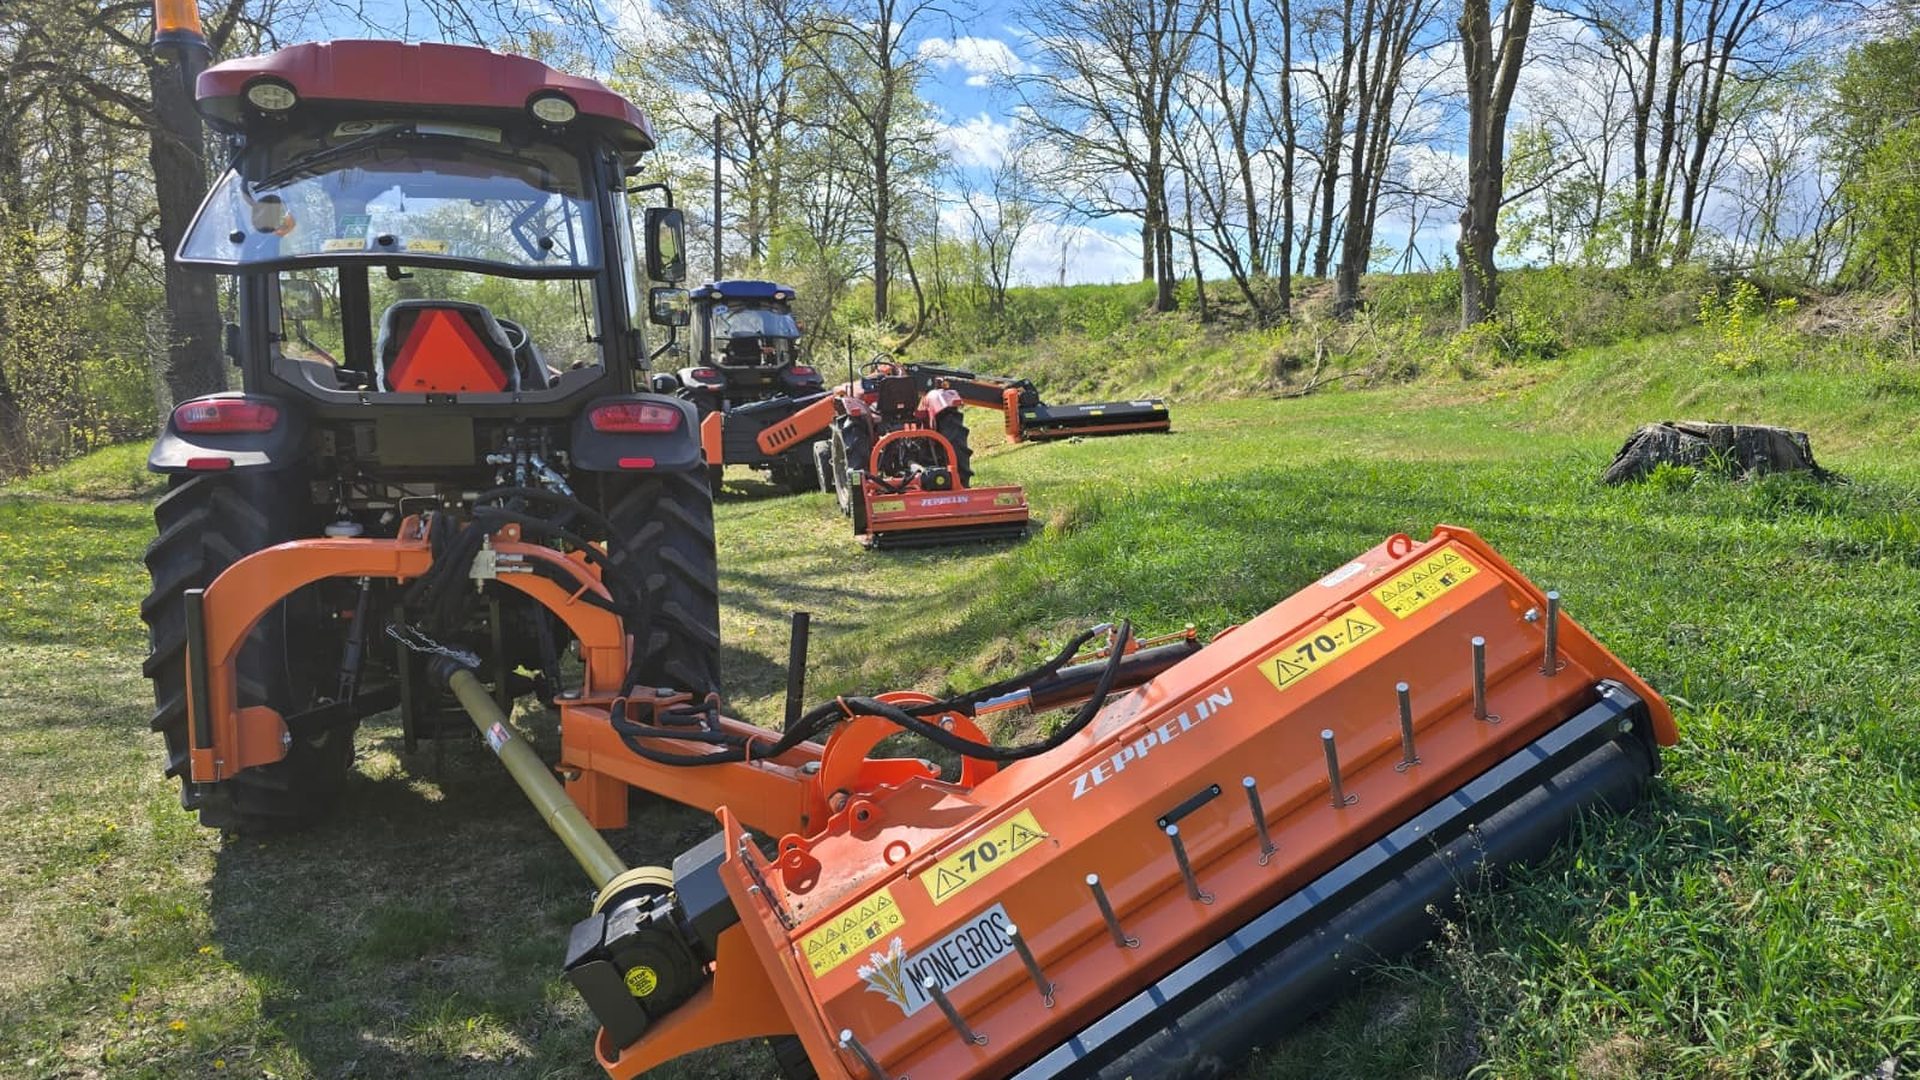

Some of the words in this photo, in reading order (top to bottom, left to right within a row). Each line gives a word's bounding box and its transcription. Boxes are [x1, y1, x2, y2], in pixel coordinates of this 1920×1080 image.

[1296, 635, 1336, 662] 70
[1069, 687, 1233, 800] ZEPPELIN
[960, 841, 997, 873] 70
[905, 912, 1013, 1002] MONEGROS
